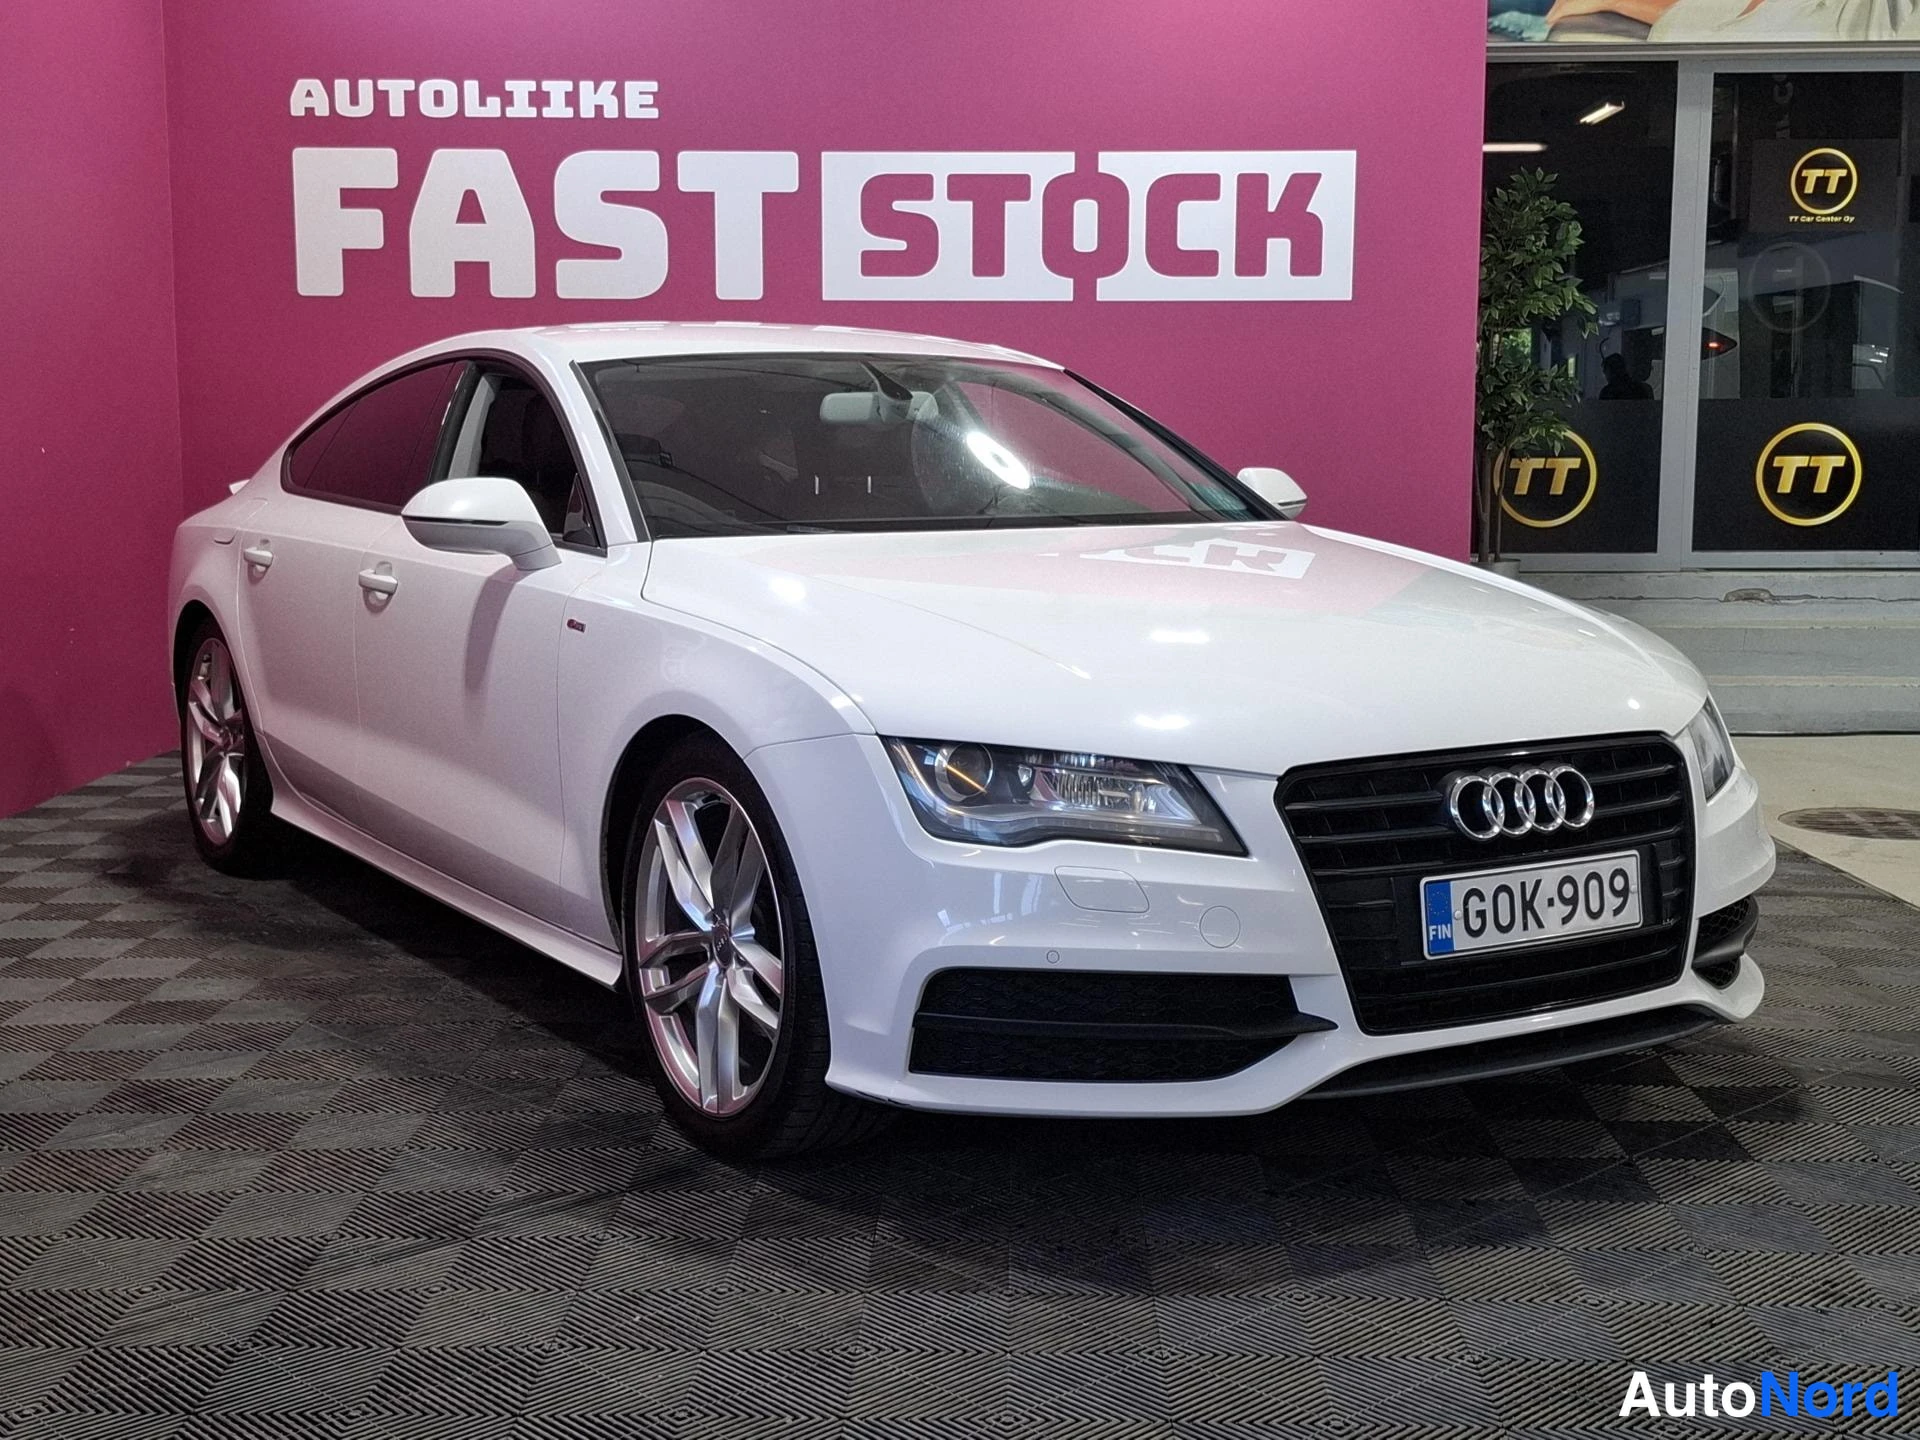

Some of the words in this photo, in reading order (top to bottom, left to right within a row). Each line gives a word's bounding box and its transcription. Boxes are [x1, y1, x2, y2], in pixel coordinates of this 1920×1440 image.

[290, 79, 659, 119] AUTOLIIKE
[1801, 168, 1848, 194] TT
[292, 148, 800, 300] FAST
[860, 172, 1324, 278] STOCK
[1843, 215, 1855, 223] Oy
[1509, 457, 1581, 495] TT
[1771, 454, 1847, 494] TT
[1429, 922, 1452, 941] FIN
